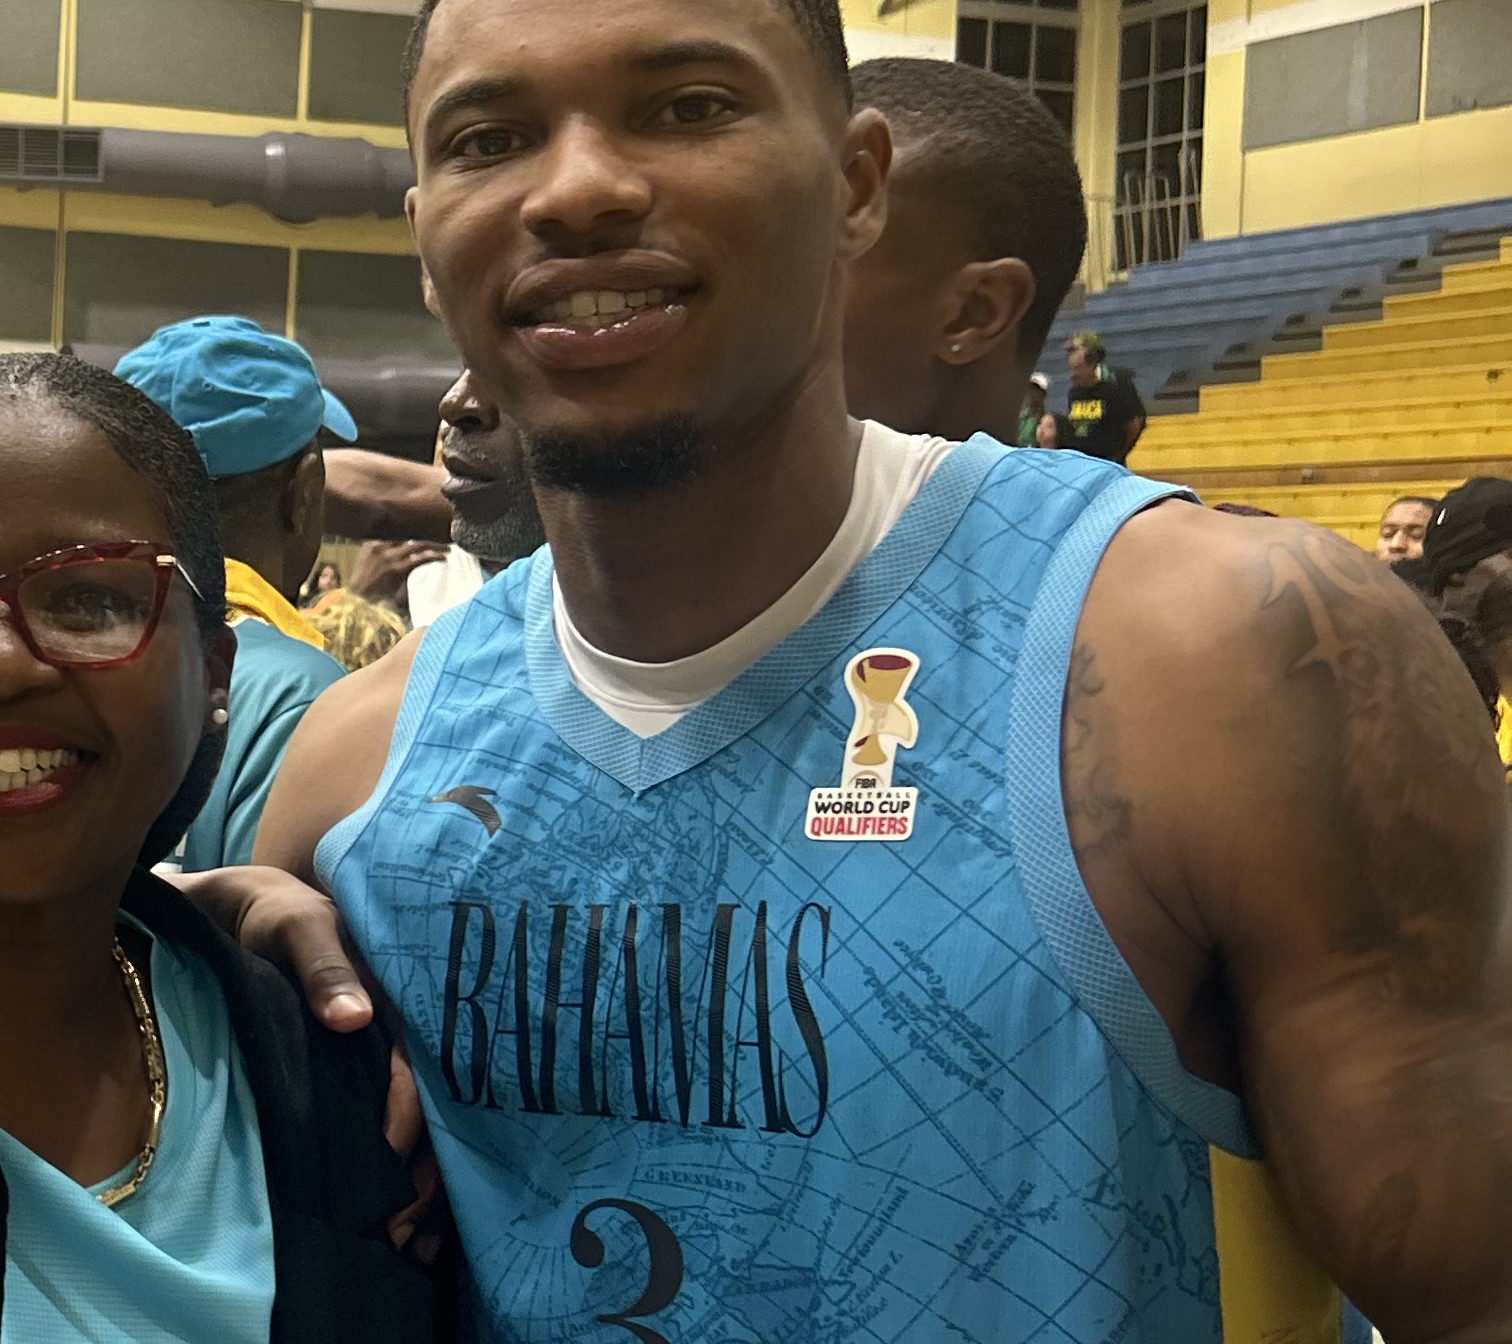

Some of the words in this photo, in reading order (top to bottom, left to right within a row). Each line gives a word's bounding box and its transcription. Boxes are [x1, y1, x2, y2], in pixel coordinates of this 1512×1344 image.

[855, 777, 877, 790] FIBA
[817, 791, 912, 800] BASKETBALL
[815, 800, 874, 815] WORLD
[879, 800, 911, 815] CUP
[810, 815, 909, 837] QUALIFIERS
[439, 899, 833, 1138] BAHAMAS
